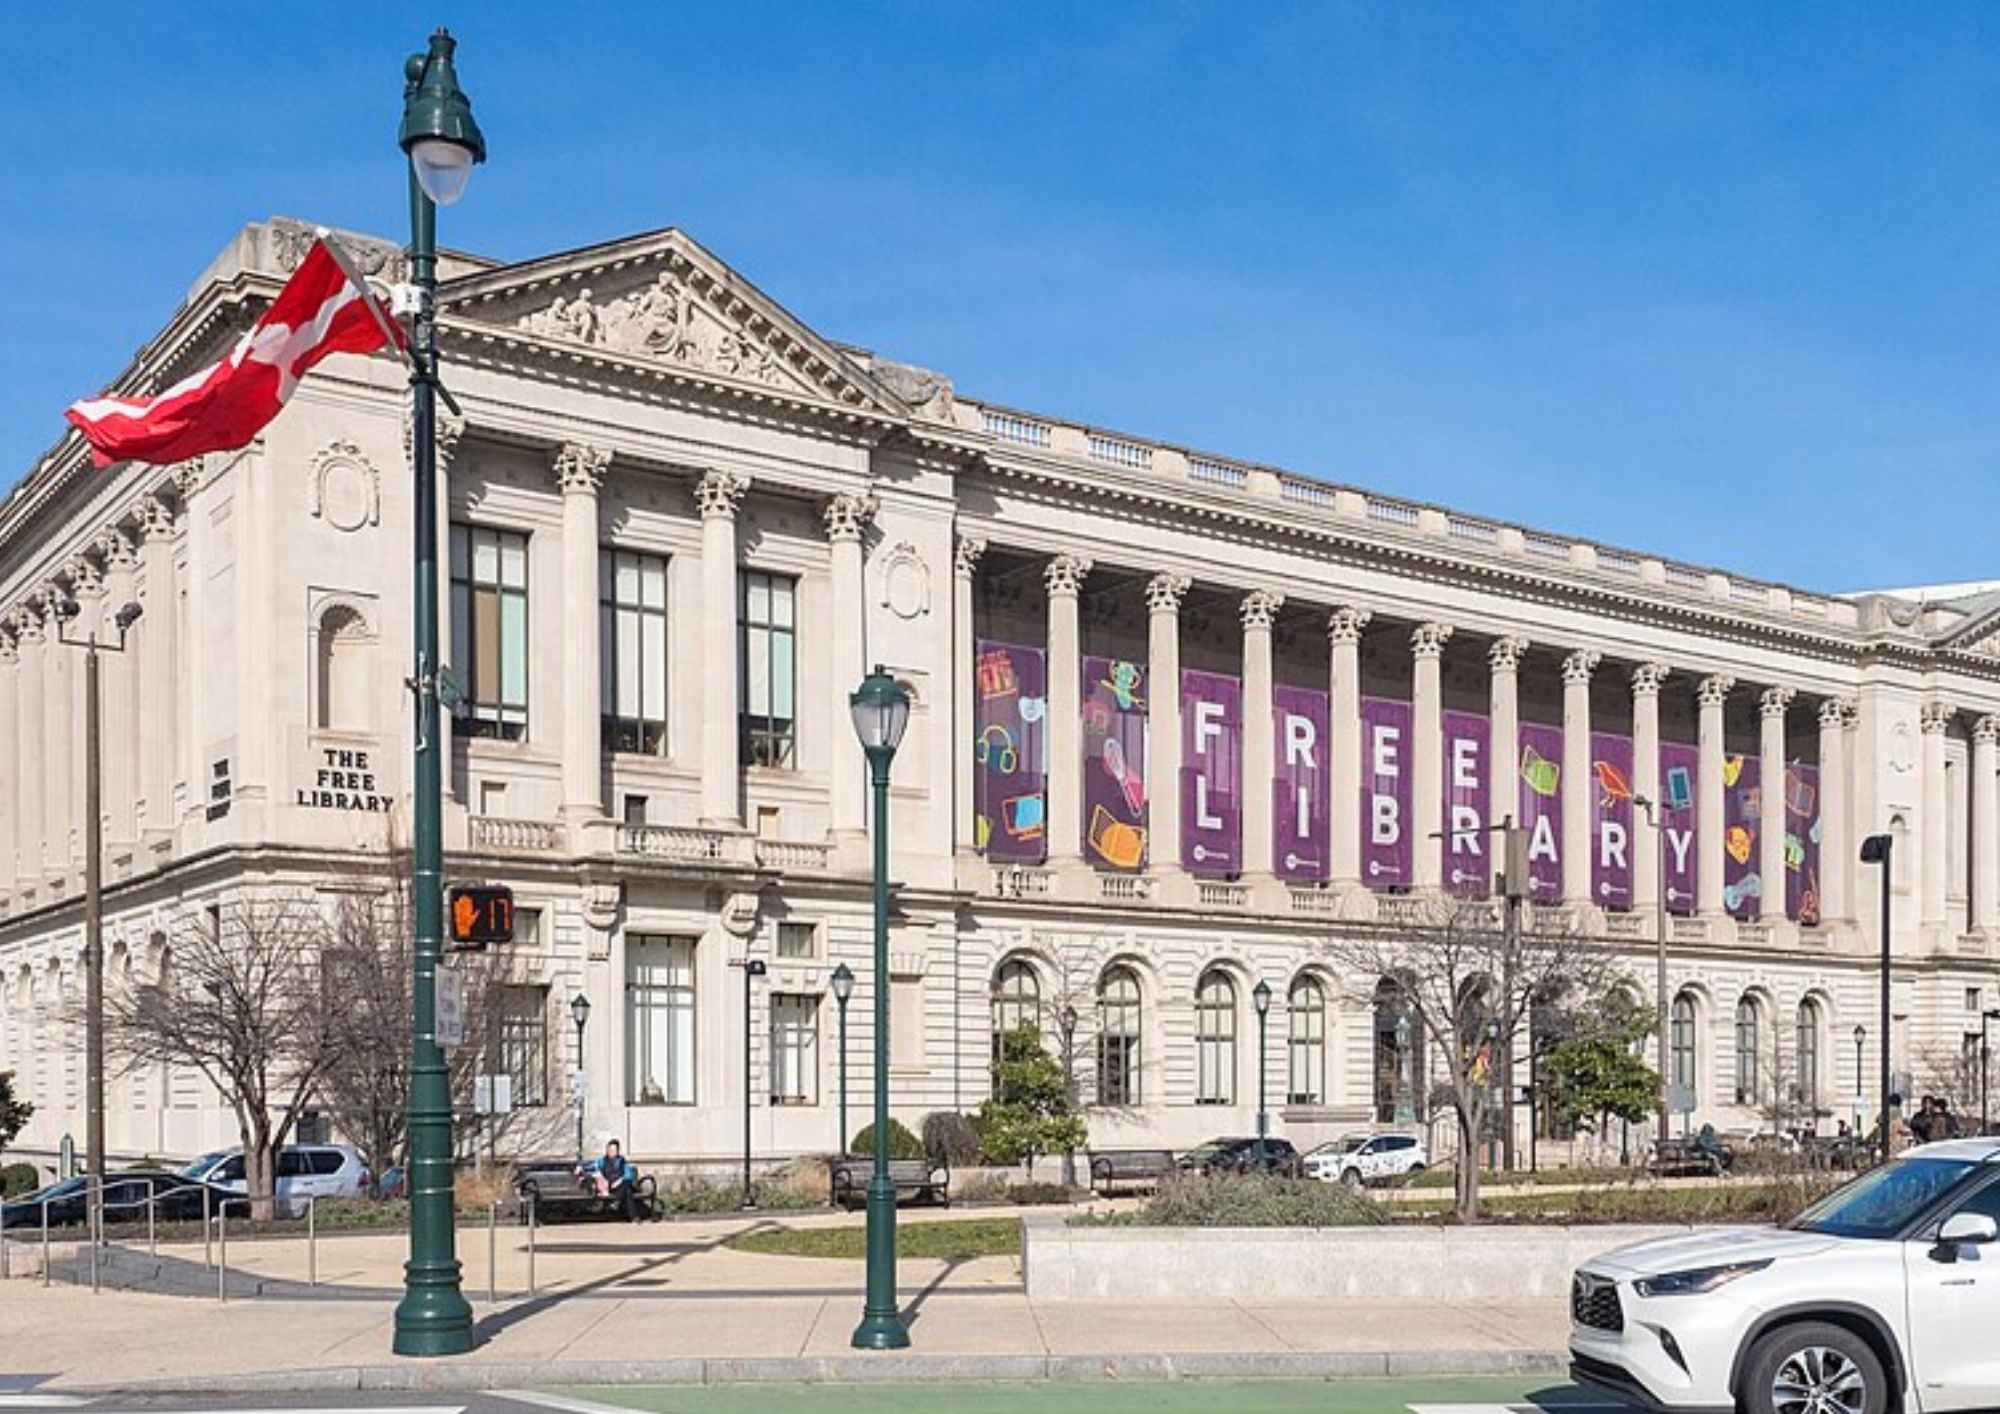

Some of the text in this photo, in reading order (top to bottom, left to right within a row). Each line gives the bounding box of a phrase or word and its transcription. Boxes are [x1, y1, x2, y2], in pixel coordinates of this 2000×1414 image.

[1195, 702, 1478, 788] FREE
[323, 749, 368, 769] THE
[317, 770, 375, 791] FREE
[297, 789, 394, 813] LIBRARY
[1195, 774, 1694, 874] LIBRARY
